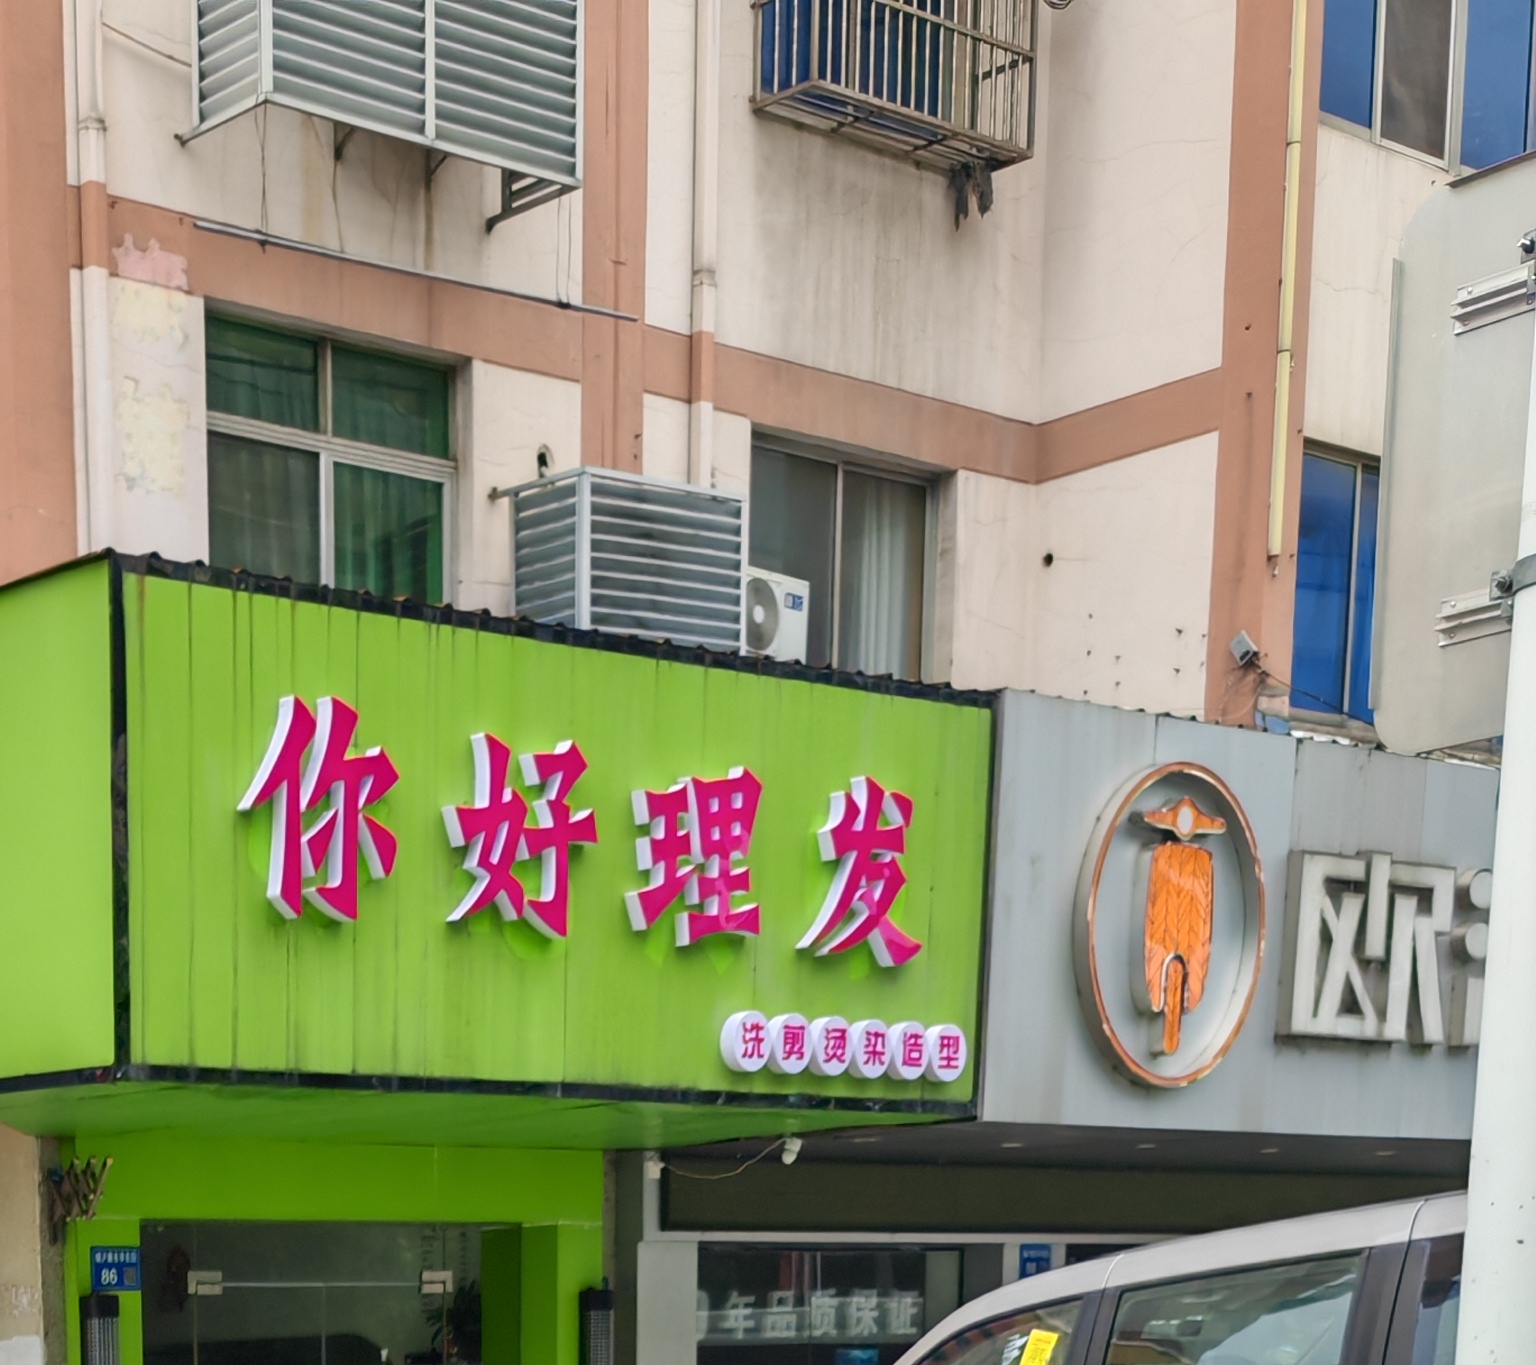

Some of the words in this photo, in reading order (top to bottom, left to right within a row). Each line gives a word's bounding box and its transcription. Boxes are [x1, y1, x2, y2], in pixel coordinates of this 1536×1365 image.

[237, 694, 923, 968] 你好理发
[1276, 849, 1494, 1048] 欧
[739, 1019, 961, 1071] 洗剪烫染造型
[100, 1267, 118, 1285] 86
